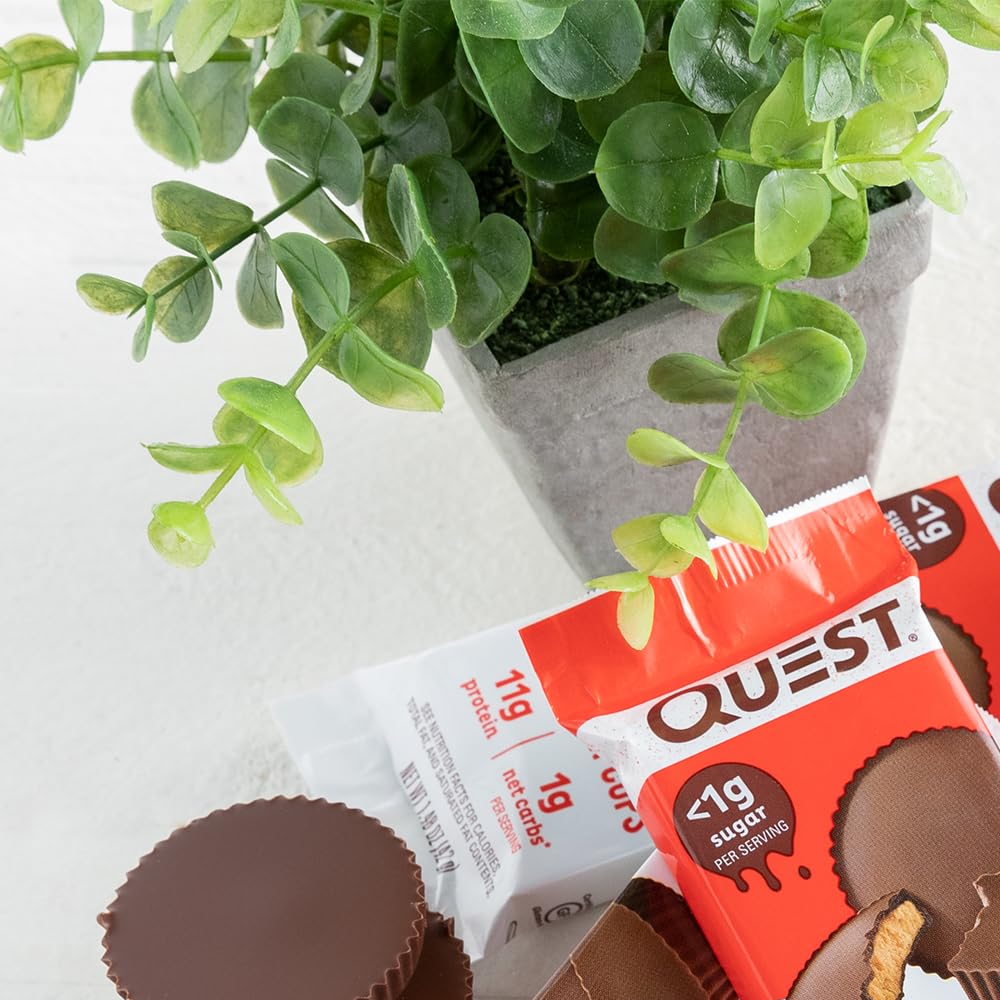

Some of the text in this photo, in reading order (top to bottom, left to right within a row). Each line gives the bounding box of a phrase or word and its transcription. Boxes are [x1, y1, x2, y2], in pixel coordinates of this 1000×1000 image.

[647, 598, 902, 743] QUEST
[459, 677, 498, 740] protein
[495, 669, 533, 721] 11g
[400, 761, 421, 789] NET
[409, 781, 428, 808] WT
[430, 720, 457, 774] NUTRITION
[450, 772, 470, 807] FACTS
[464, 803, 478, 826] FOR
[502, 768, 526, 798] net
[537, 771, 574, 814] 1g
[435, 767, 465, 825] SATURATED
[460, 824, 473, 842] FAT
[686, 775, 755, 820] <1g
[710, 805, 767, 848] sugar
[714, 820, 789, 871] PER SERVING
